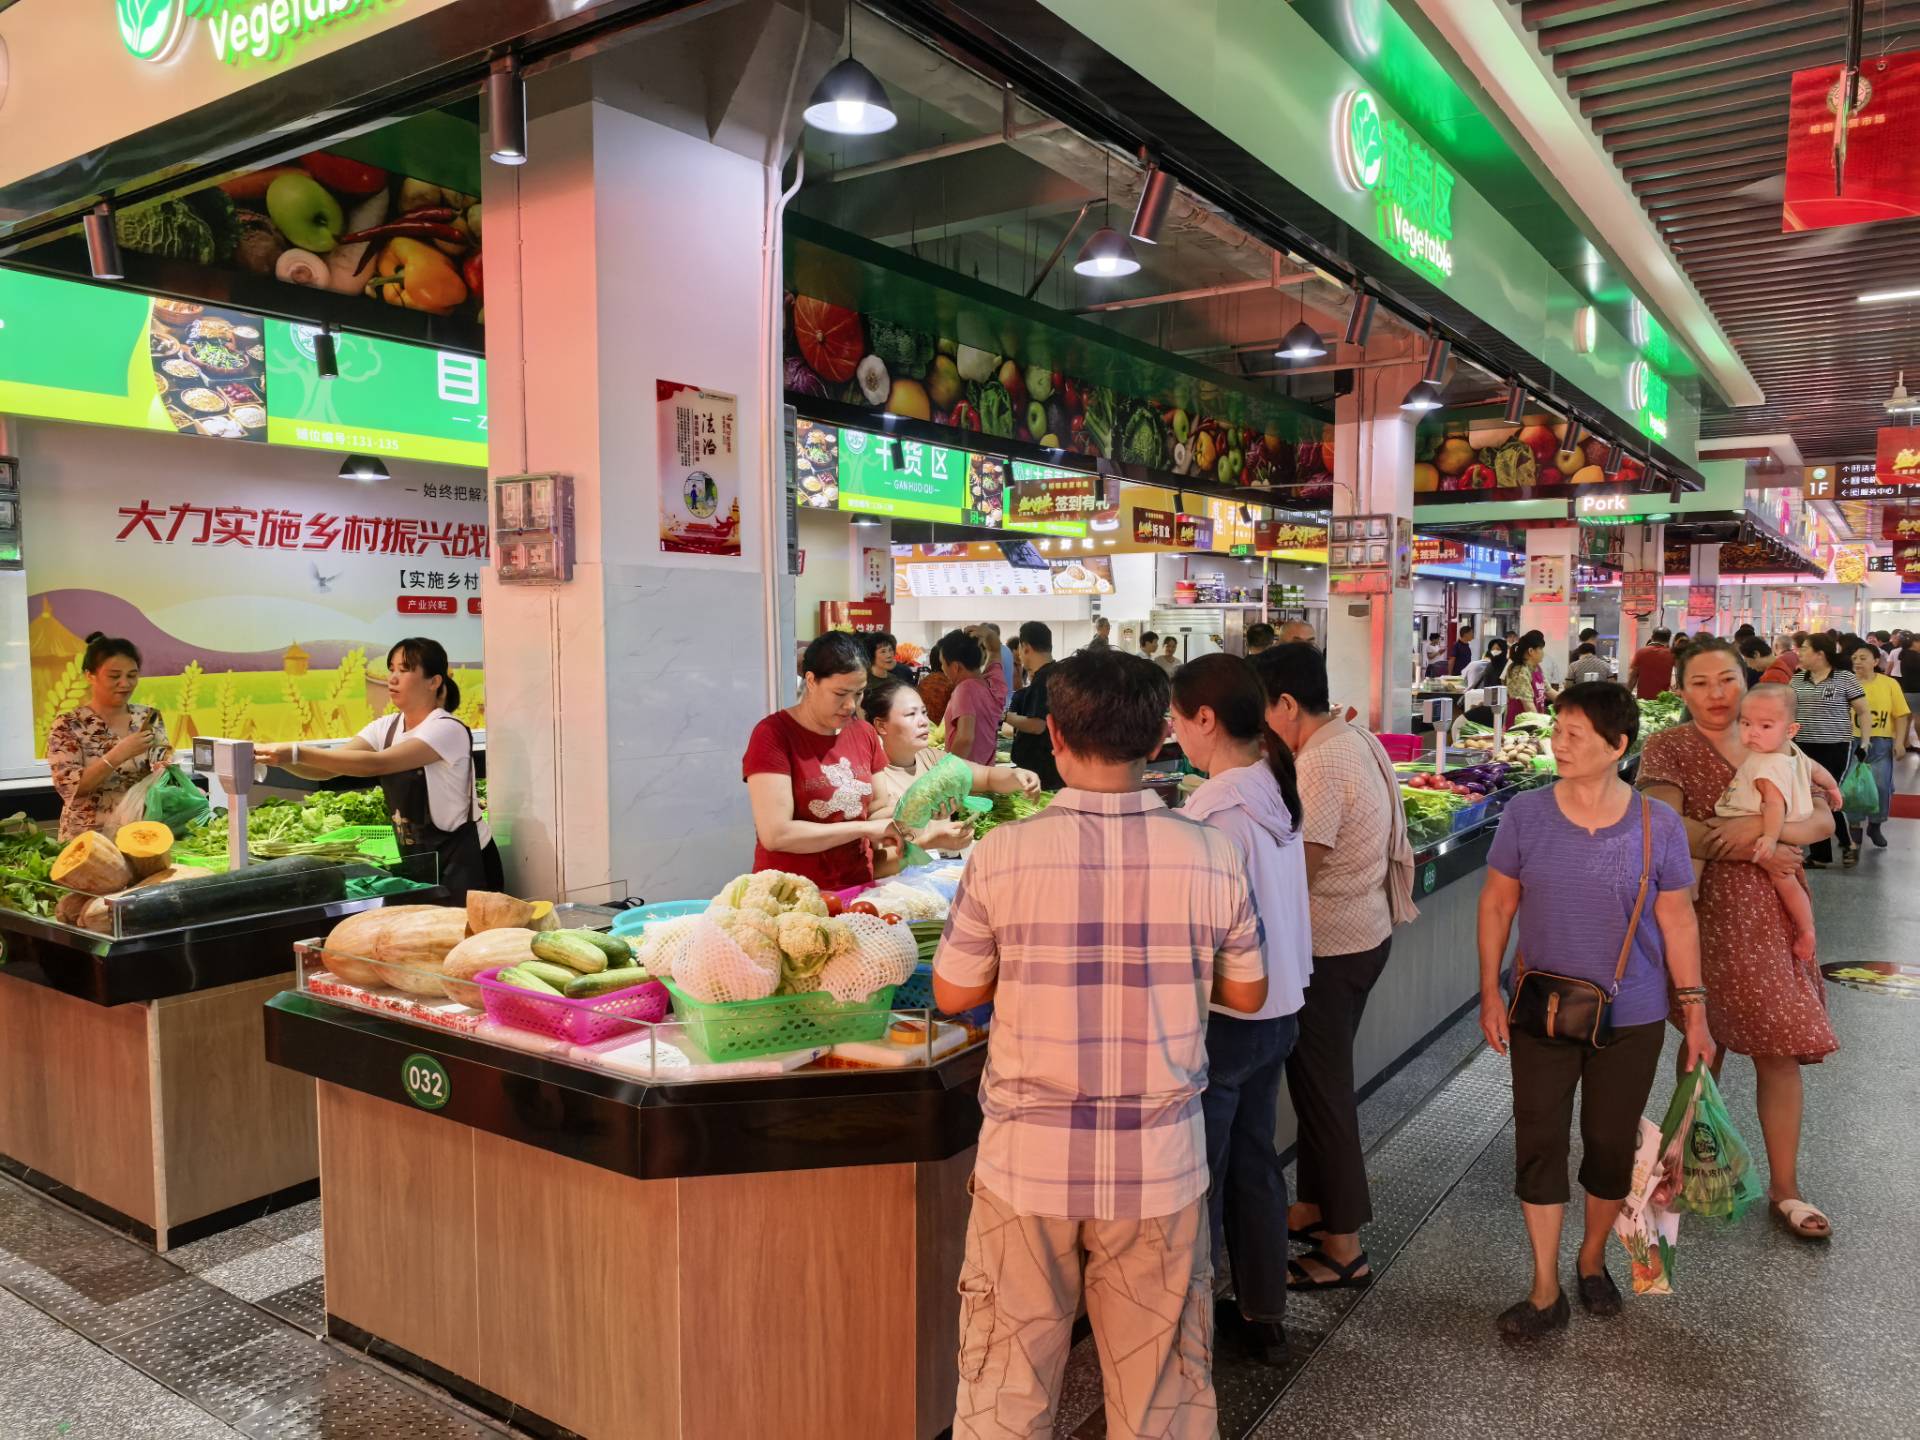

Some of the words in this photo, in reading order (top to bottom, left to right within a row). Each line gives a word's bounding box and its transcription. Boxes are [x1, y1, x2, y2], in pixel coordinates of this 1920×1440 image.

[1393, 203, 1453, 277] Vegetable
[701, 412, 718, 456] 法治
[875, 435, 949, 480] 干货区
[1583, 495, 1626, 512] Pork
[1809, 481, 1829, 496] 1F
[115, 500, 491, 559] 大力实施乡村振兴战
[407, 599, 448, 611] 产业兴旺
[409, 1065, 443, 1097] 032
